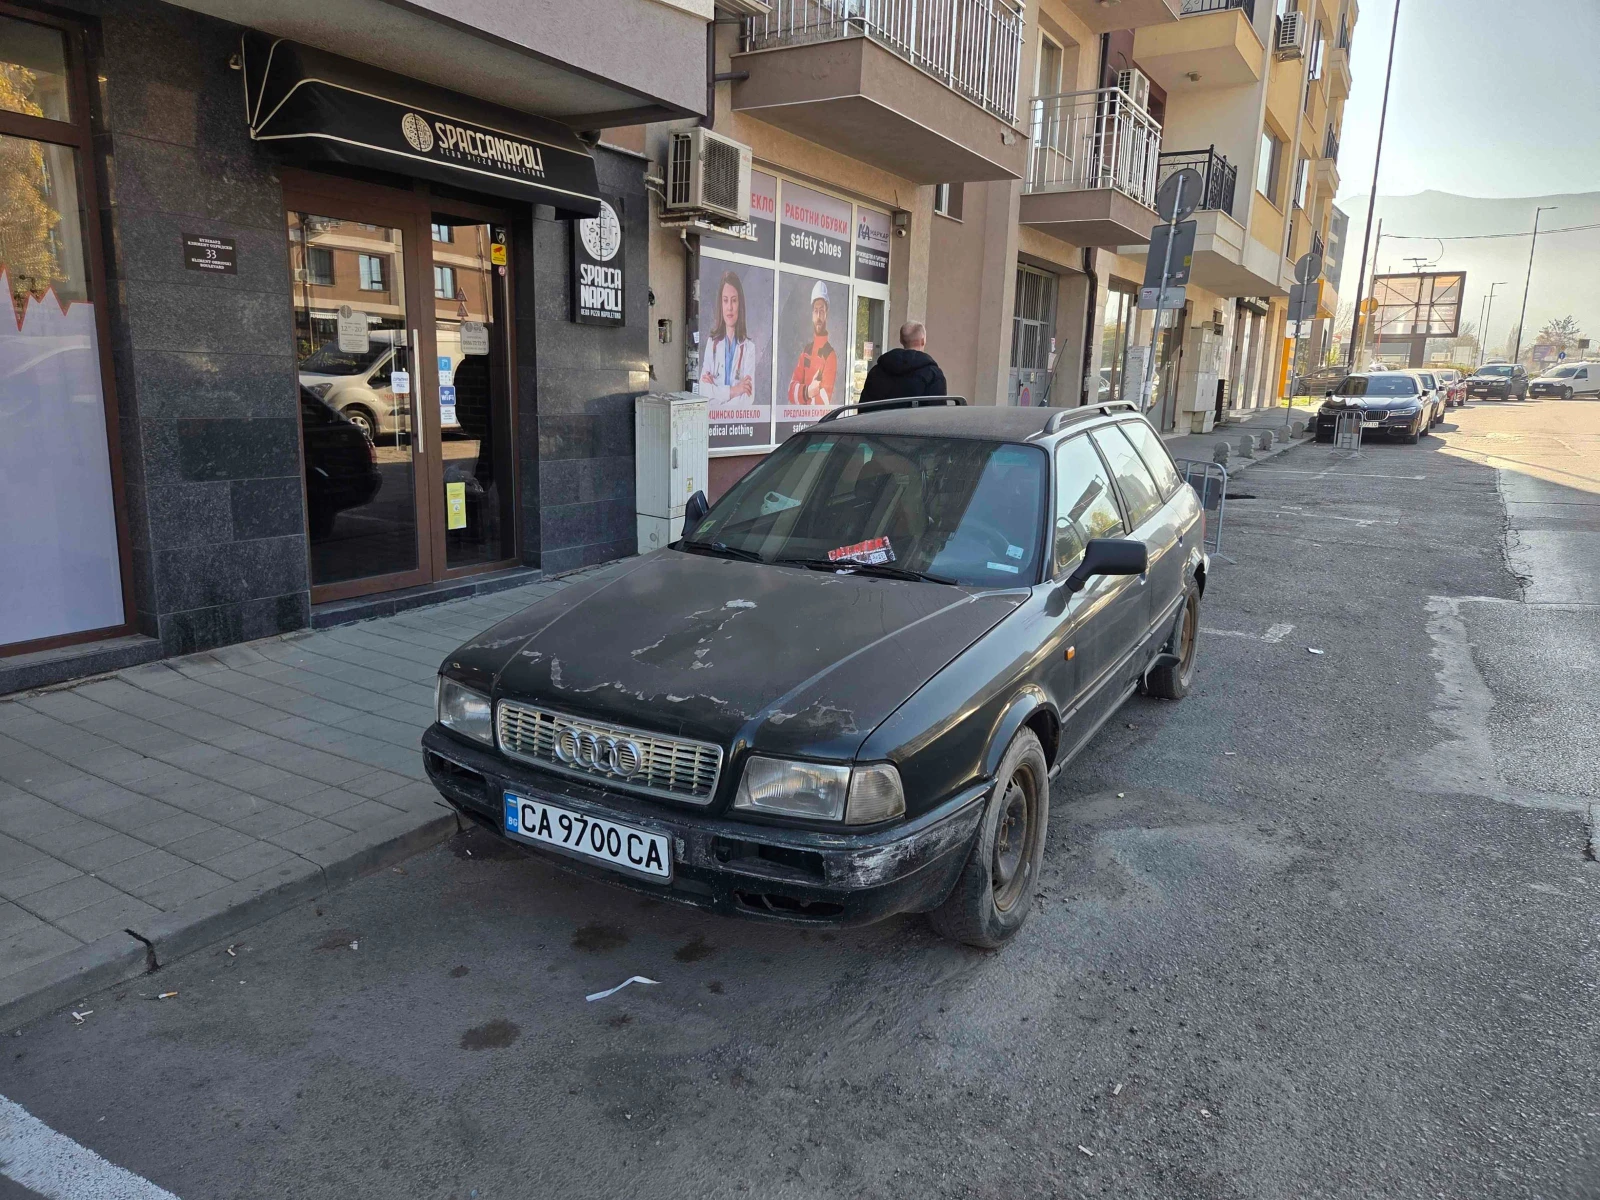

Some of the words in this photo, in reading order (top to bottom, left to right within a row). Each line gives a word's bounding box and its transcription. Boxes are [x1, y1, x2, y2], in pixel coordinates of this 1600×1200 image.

[434, 121, 545, 172] SPACCANAPOLI
[751, 193, 774, 214] ЕКЛО
[785, 203, 819, 227] РАБОТНИ
[820, 214, 849, 235] ОБУВКИ
[206, 249, 217, 259] 33
[790, 231, 818, 256] safety
[818, 238, 842, 258] shoes
[580, 263, 622, 290] SPACCA
[580, 284, 622, 312] NAPOLI
[708, 409, 734, 420] ИЦИНСКО
[735, 409, 761, 419] ОБЛЕКЛО
[708, 425, 728, 437] edical
[728, 424, 754, 437] clothing
[508, 816, 518, 827] BG
[521, 803, 553, 839] CA
[558, 813, 622, 857] 9700
[627, 833, 664, 871] CA
